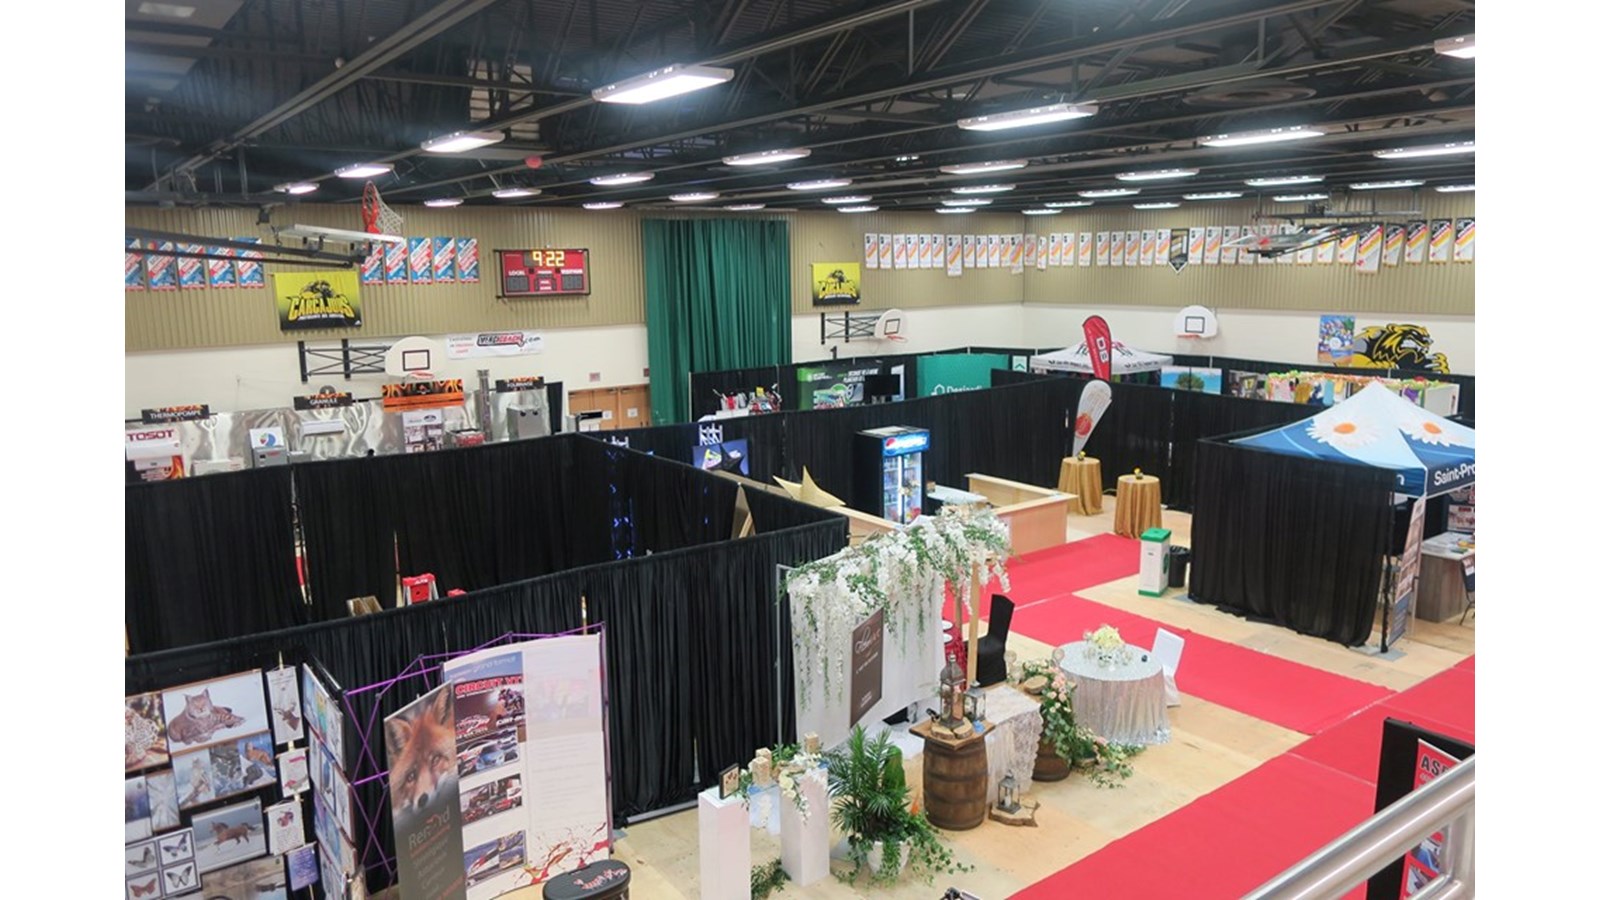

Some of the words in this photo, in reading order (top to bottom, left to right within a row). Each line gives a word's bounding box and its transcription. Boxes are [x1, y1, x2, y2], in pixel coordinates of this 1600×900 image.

[532, 250, 565, 267] 9:22
[286, 295, 355, 321] CARCAJOUS
[127, 429, 175, 442] TOSOT
